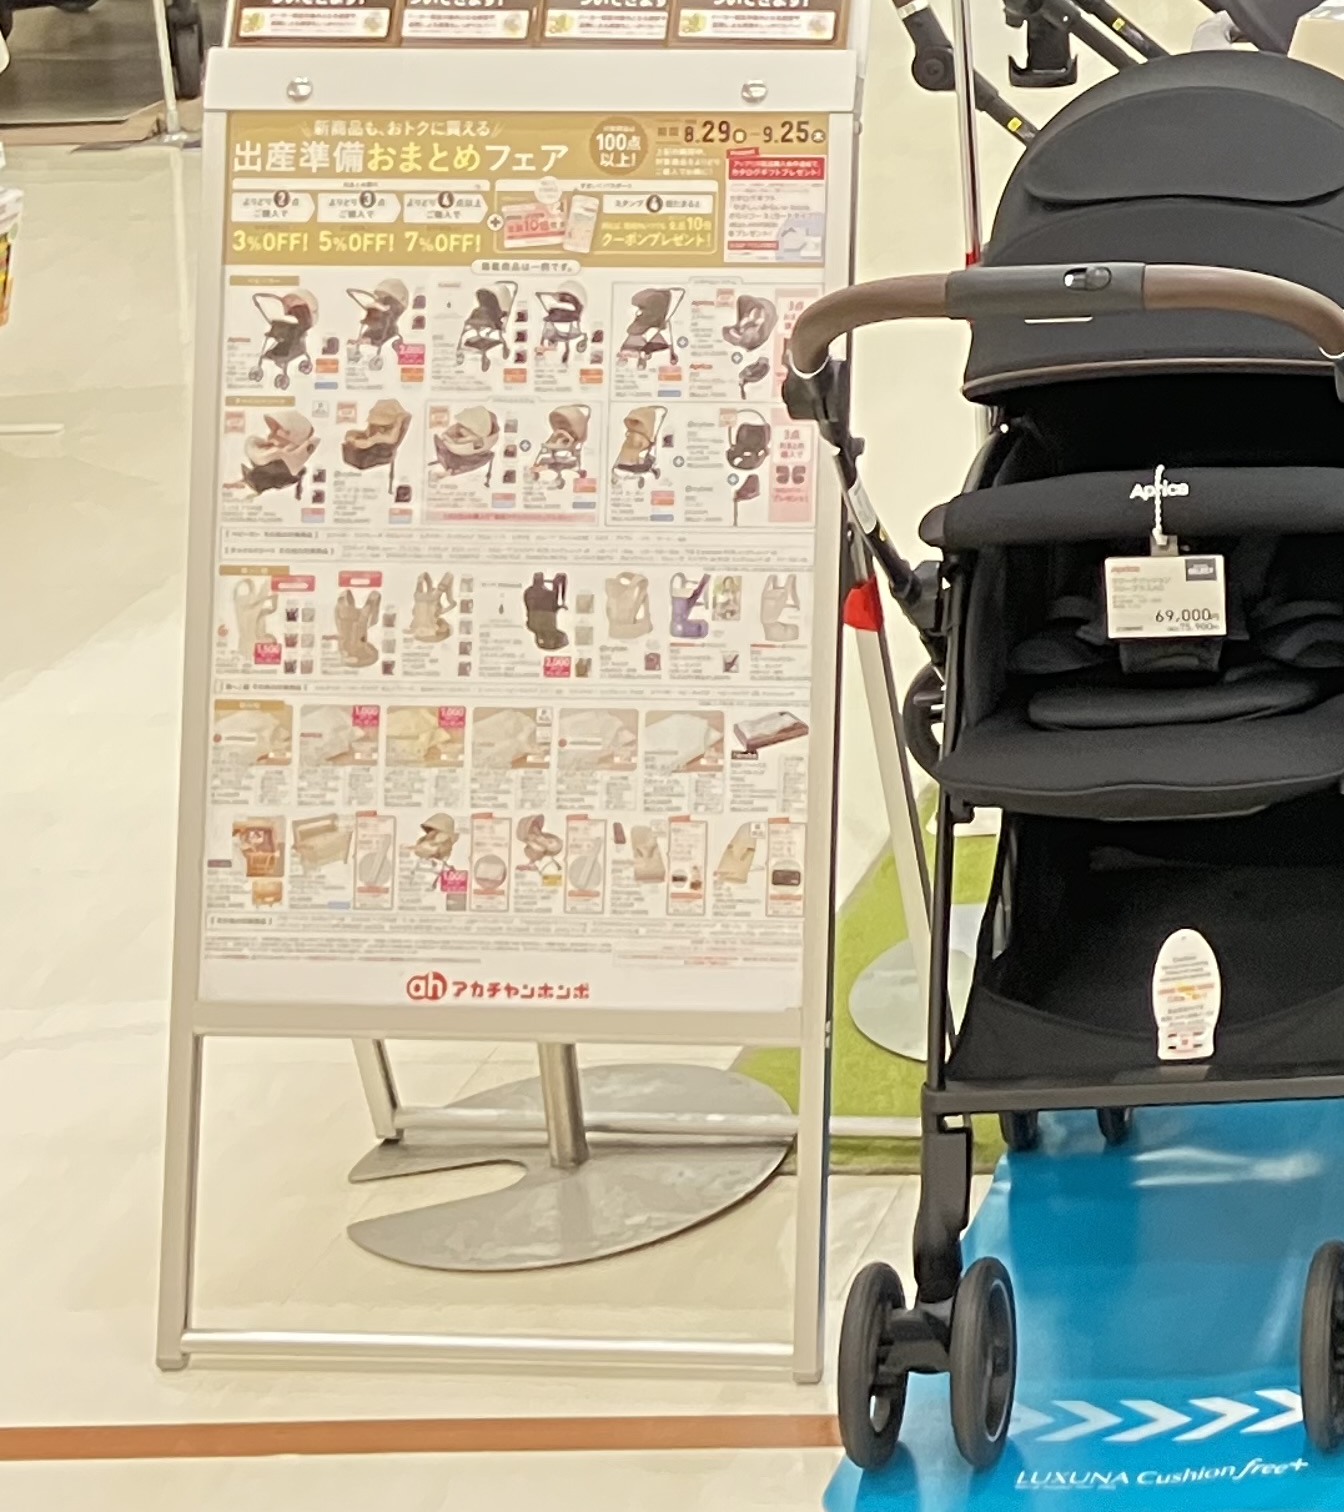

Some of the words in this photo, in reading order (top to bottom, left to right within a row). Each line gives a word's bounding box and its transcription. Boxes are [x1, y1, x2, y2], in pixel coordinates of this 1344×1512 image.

[313, 119, 491, 138] 新商品も、おトクに買える
[233, 141, 569, 173] 出産準備おまとめフェア
[232, 231, 308, 254] 3%OFF!
[319, 231, 394, 254] 5%OFF!
[405, 231, 481, 254] 7%OFF!
[452, 981, 590, 1001] アカチャンホンポ
[1014, 1469, 1130, 1488] LUXUNA
[1137, 1462, 1236, 1486] Cushion
